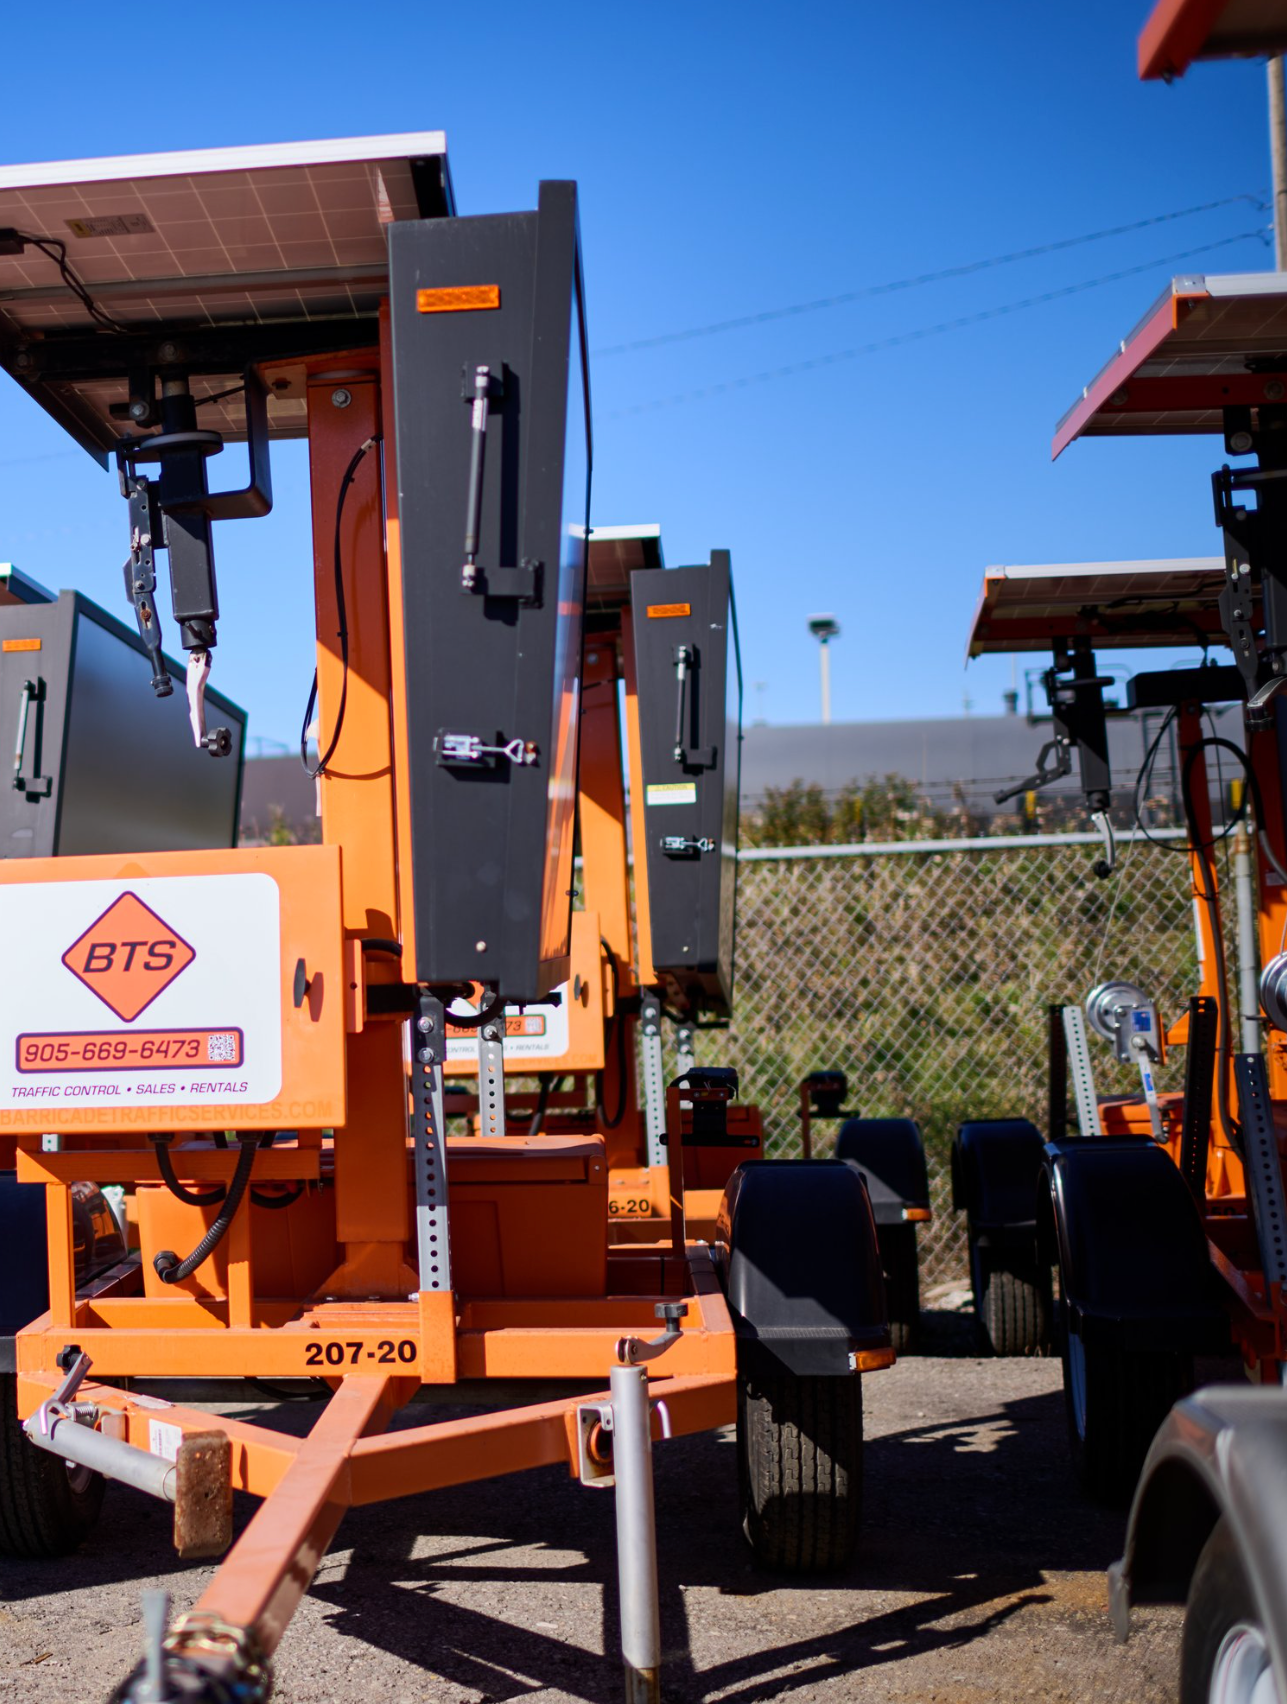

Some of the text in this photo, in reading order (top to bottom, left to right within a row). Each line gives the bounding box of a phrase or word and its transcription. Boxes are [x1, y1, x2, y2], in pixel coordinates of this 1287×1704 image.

[82, 940, 177, 973] BTS
[24, 1039, 201, 1062] 905-669-6473
[11, 1082, 248, 1098] TRAFFIC CONTROL SALES RENTALS
[305, 1340, 417, 1366] 207-20
